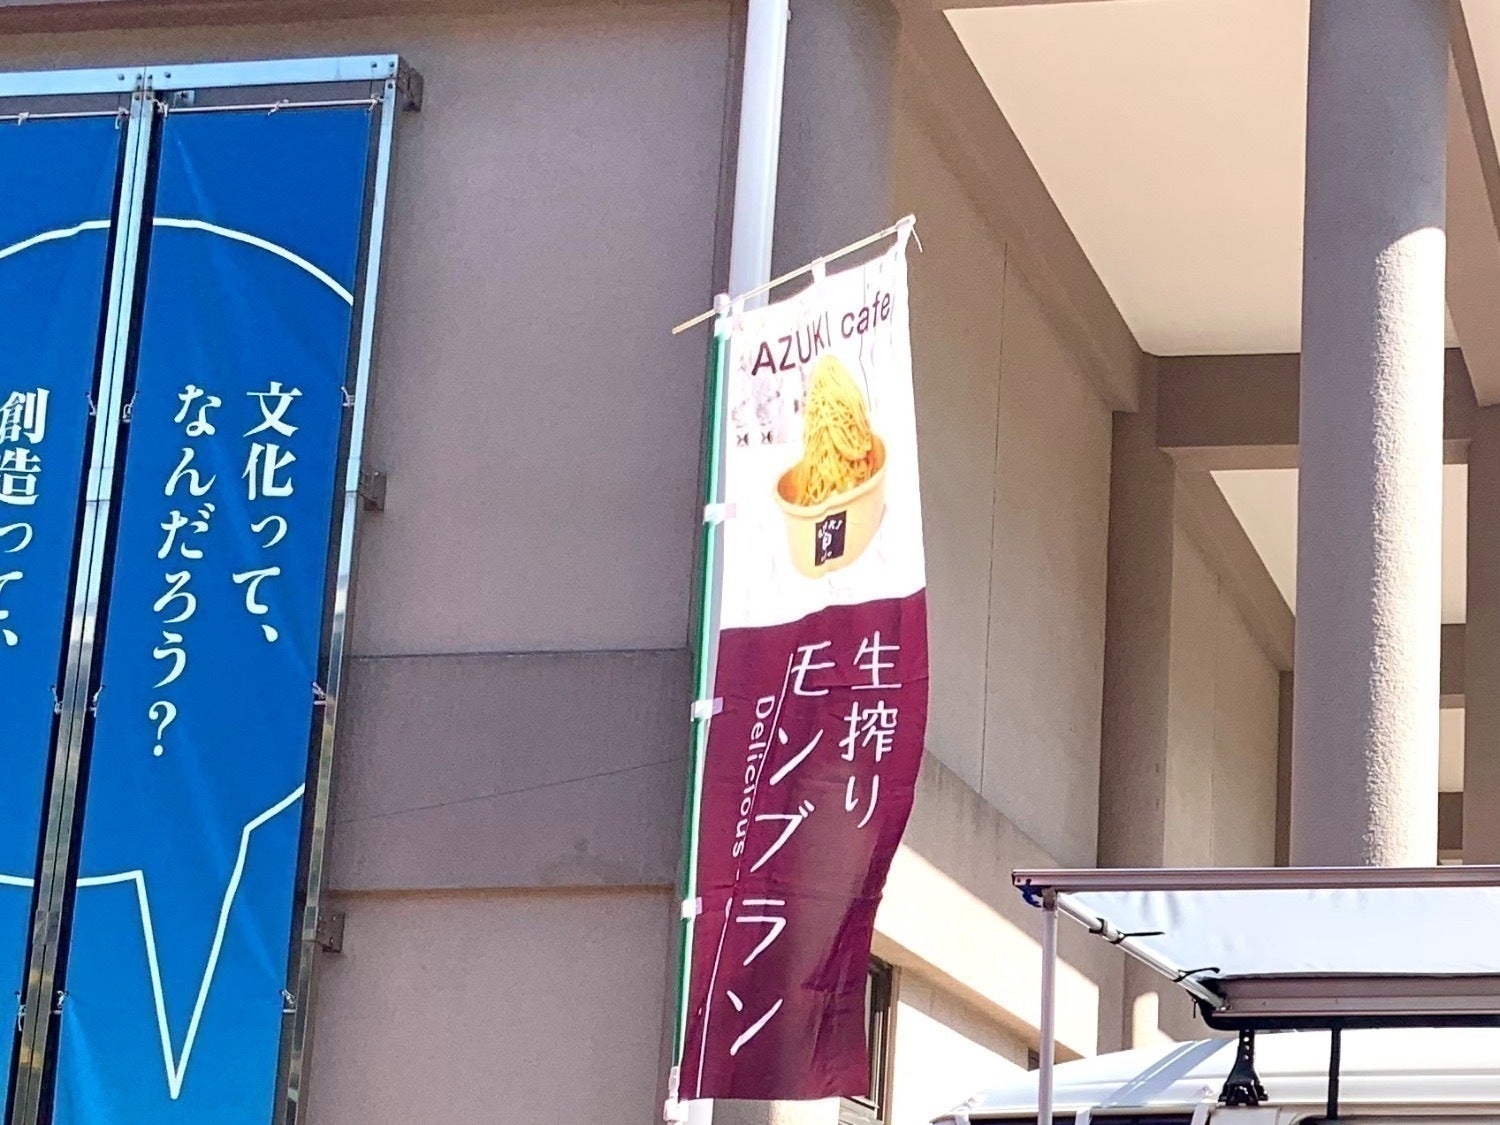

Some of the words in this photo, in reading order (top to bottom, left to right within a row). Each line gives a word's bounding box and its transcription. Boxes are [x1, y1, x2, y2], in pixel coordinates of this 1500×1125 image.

[750, 315, 831, 377] AZUKI
[841, 291, 891, 339] cafe
[148, 383, 222, 758] なんだろう？
[231, 381, 302, 643] 文化って、
[731, 694, 775, 857] Delicious
[839, 630, 902, 828] 生搾り
[727, 641, 835, 1056] モンブラン
